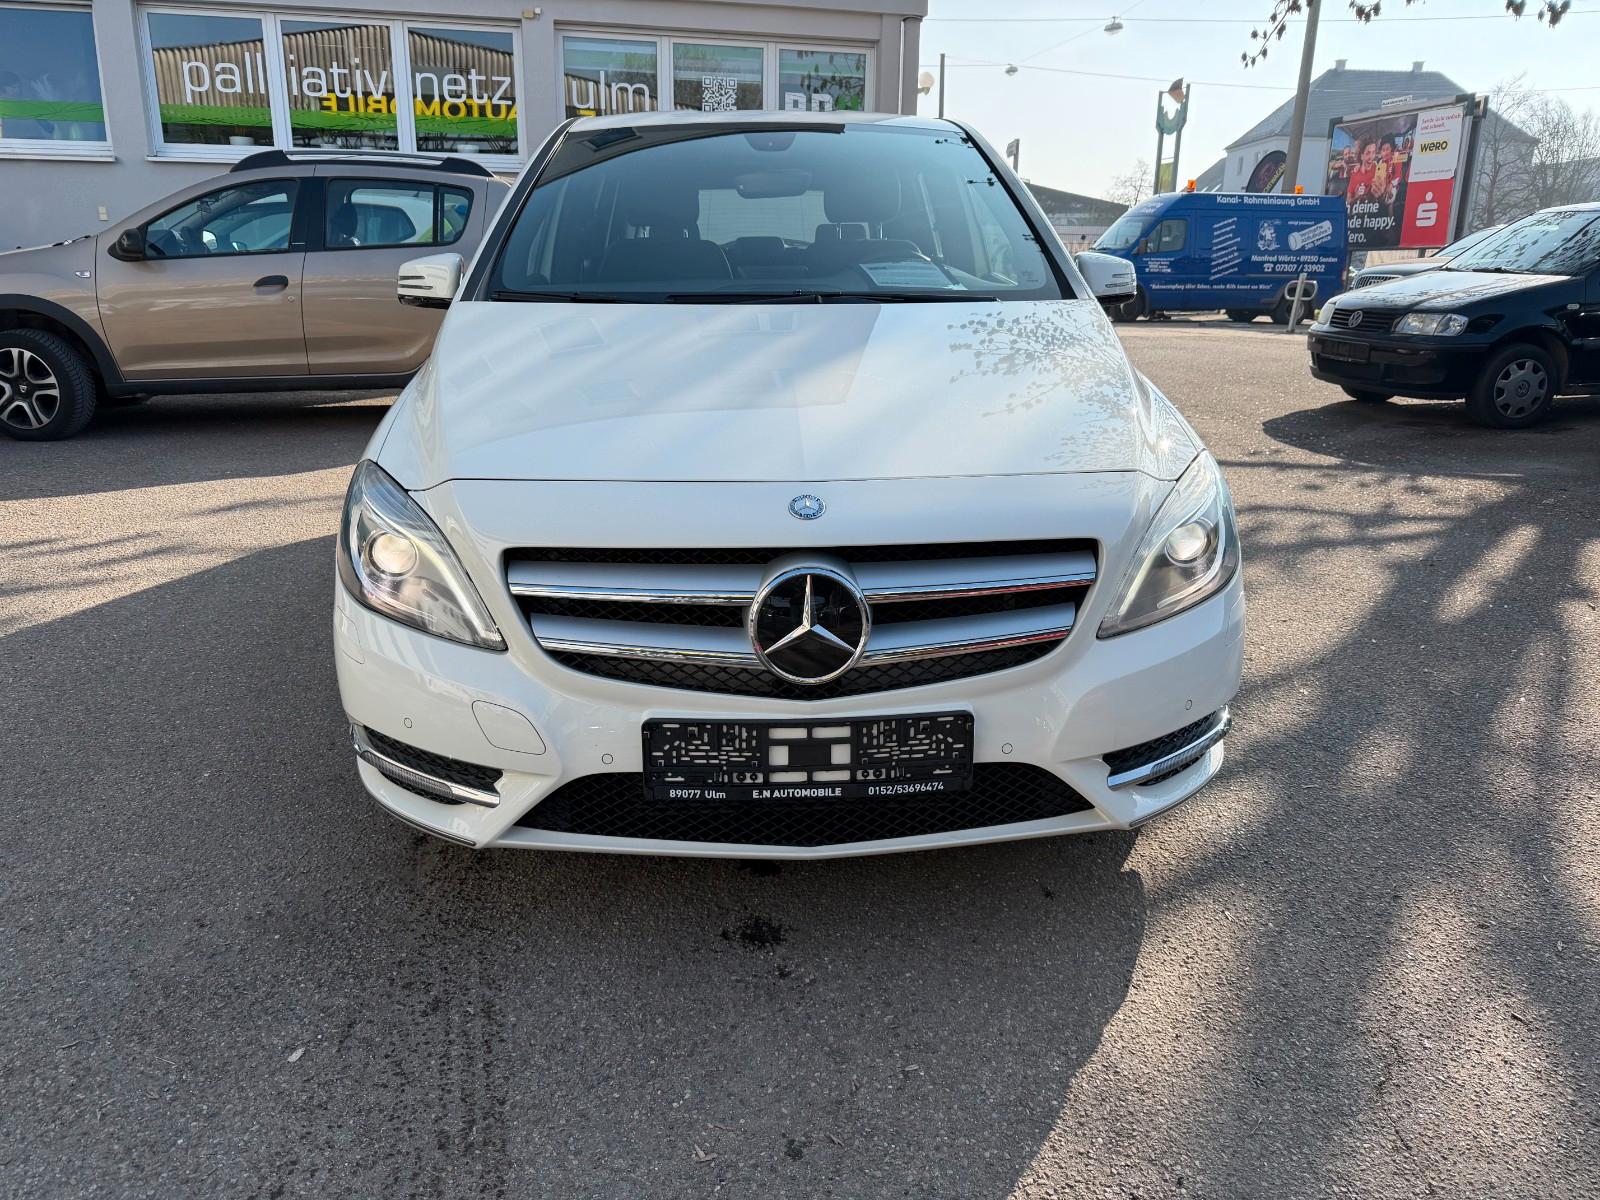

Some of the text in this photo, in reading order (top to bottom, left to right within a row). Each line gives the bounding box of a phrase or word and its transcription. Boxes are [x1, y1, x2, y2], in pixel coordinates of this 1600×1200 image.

[414, 67, 513, 106] netz
[571, 70, 650, 113] ulm
[1297, 196, 1320, 206] GmbH
[1352, 200, 1379, 213] deine
[1363, 214, 1396, 230] happy.
[1275, 264, 1297, 272] 07307
[1303, 264, 1325, 272] 33902
[669, 781, 944, 799] 89077 Ulm E.N AUTOMOBILE 0152/53696474
